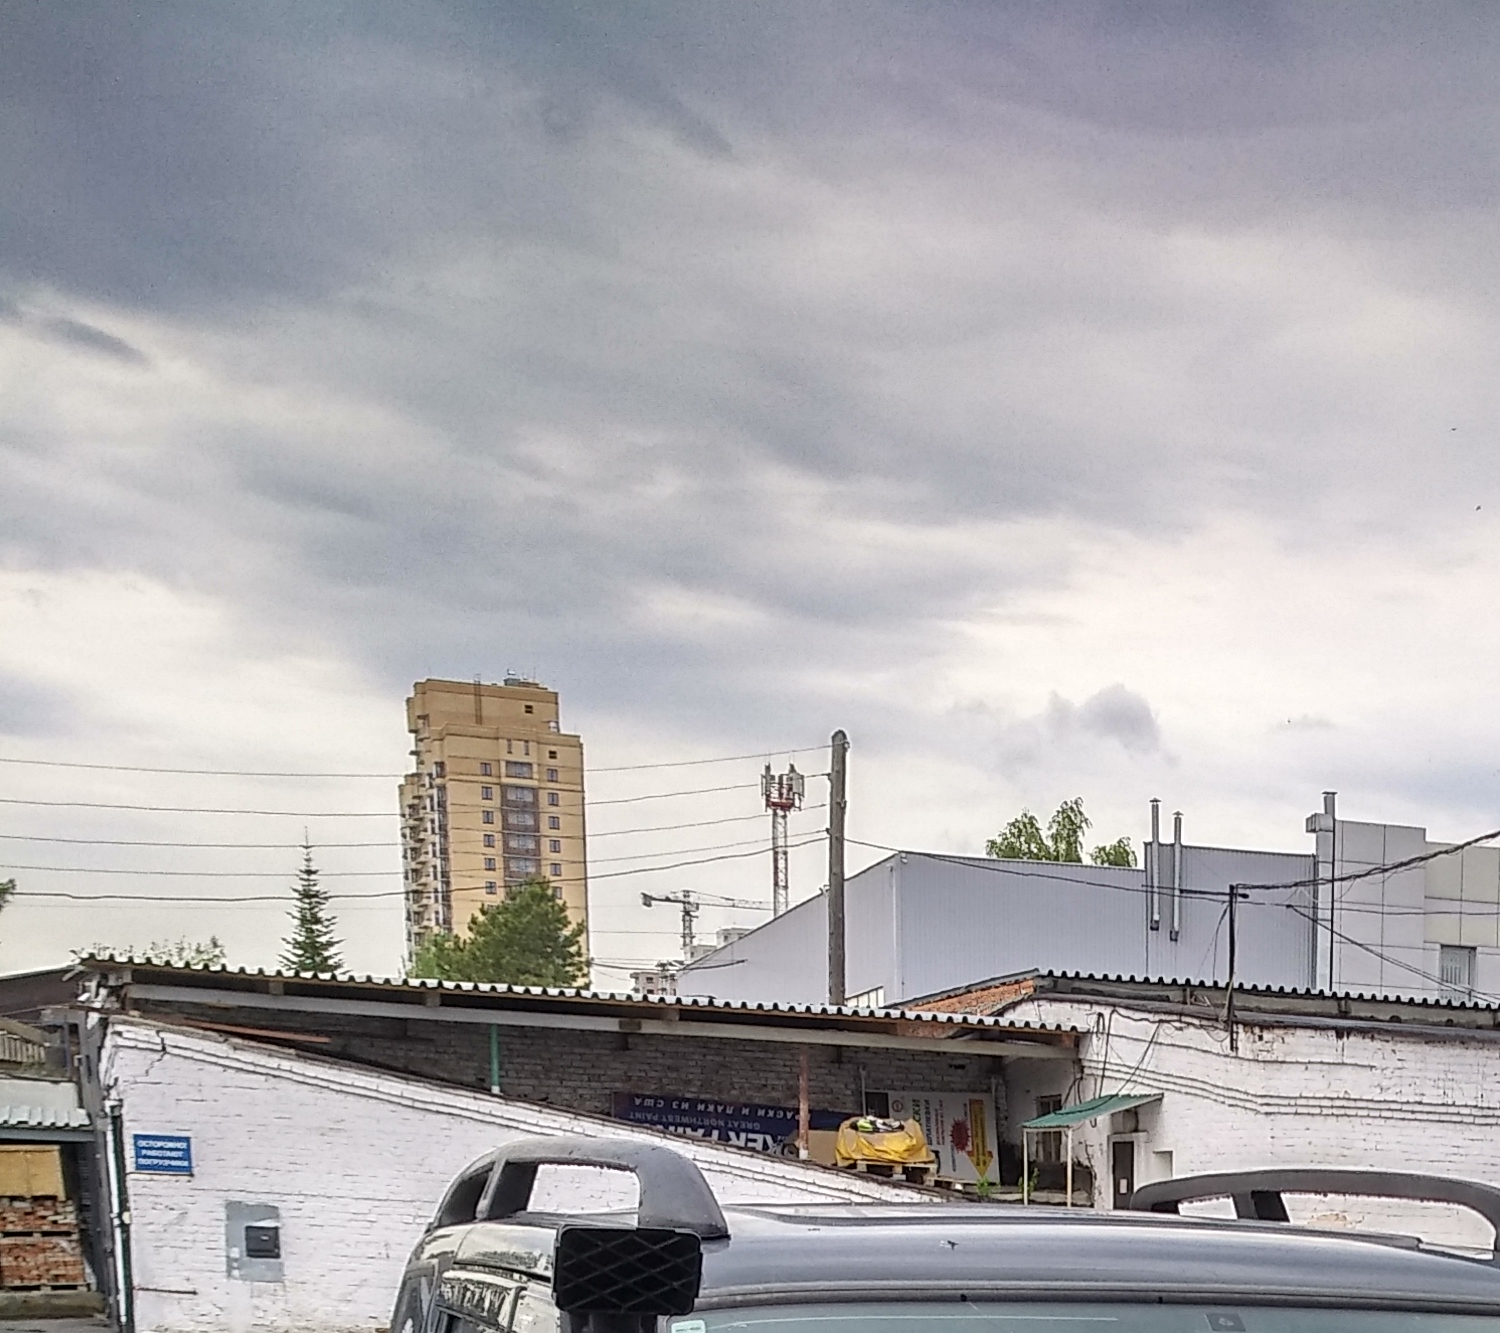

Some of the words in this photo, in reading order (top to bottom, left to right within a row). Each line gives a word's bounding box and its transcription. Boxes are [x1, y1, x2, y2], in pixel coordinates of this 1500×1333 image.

[634, 1097, 665, 1108] США
[672, 1100, 689, 1110] ИЗ
[696, 1103, 734, 1115] ЛАКИ
[741, 1106, 750, 1116] И
[629, 1111, 659, 1121] PAINT
[662, 1114, 726, 1126] NORTHWEST
[727, 1120, 760, 1130] GREAT
